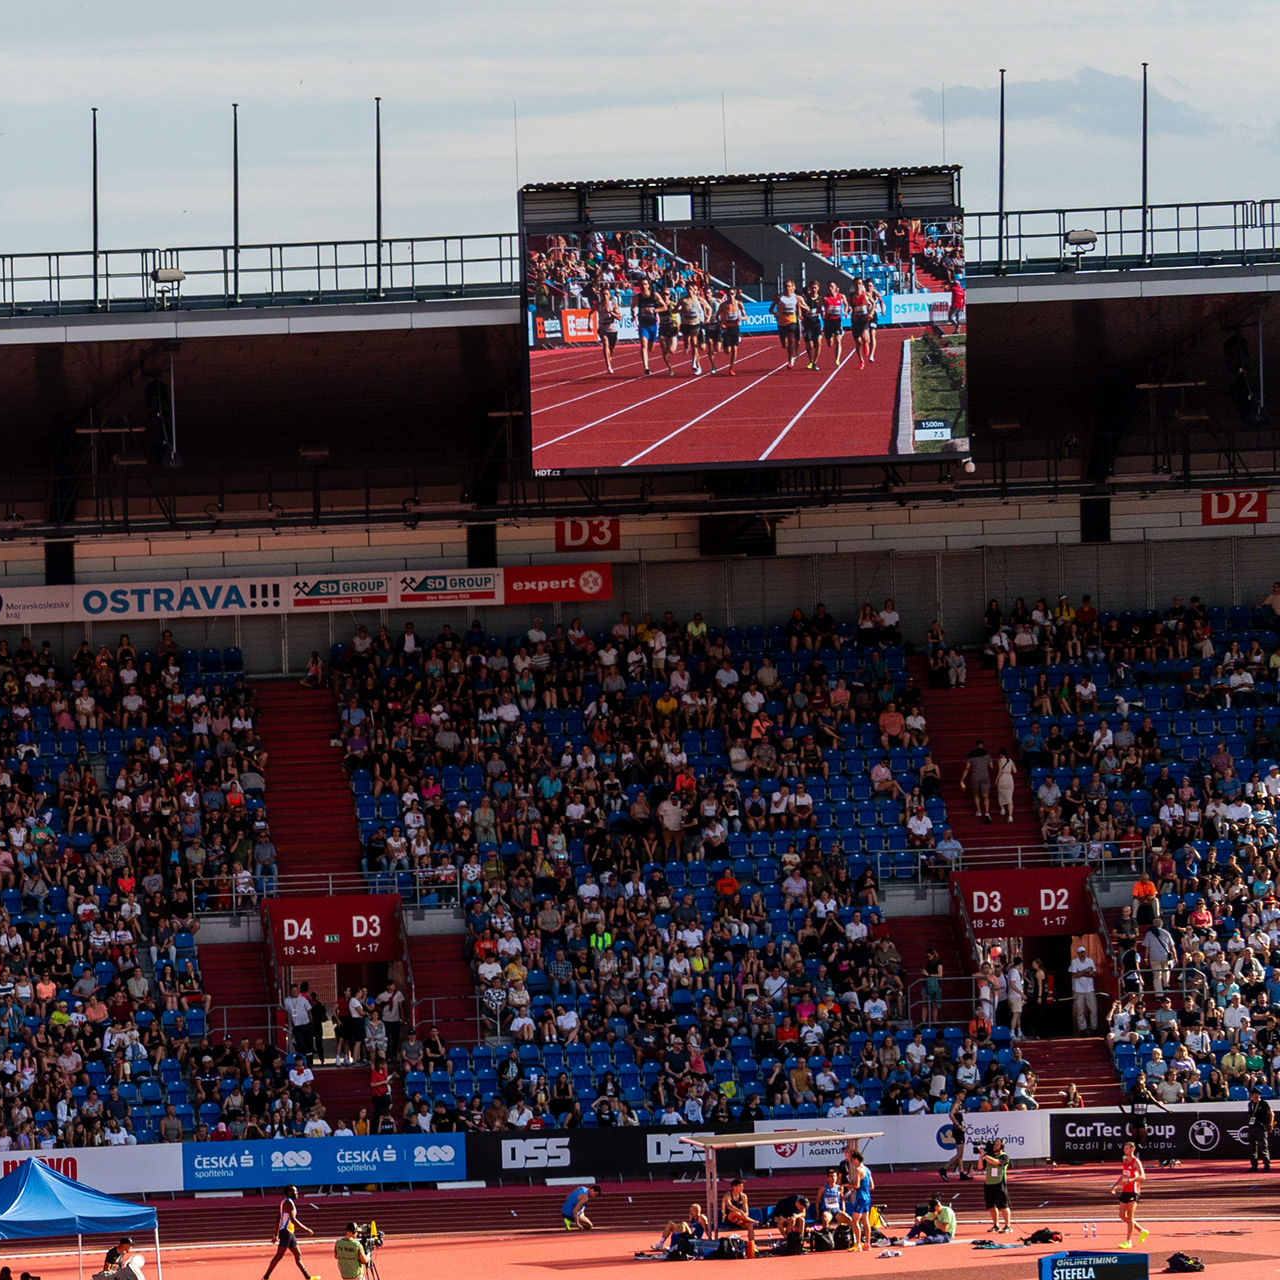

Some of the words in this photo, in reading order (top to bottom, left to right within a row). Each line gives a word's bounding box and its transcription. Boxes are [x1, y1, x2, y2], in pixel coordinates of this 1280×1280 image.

[535, 469, 561, 477] HDT.cz
[1211, 492, 1258, 519] D2
[564, 518, 612, 547] D3
[319, 583, 338, 594] SD
[342, 581, 384, 592] GROUP
[426, 578, 445, 590] SD
[449, 577, 492, 588] GROUP
[512, 577, 576, 592] expert
[5, 600, 70, 613] Moravskoslezský
[5, 611, 21, 620] kraj
[973, 891, 1002, 913] D3
[1040, 888, 1069, 910] D2
[284, 918, 313, 941] D4
[352, 915, 381, 938] D3
[965, 1124, 999, 1137] Český
[1065, 1123, 1122, 1138] CarTec
[1065, 1141, 1099, 1150] Rozdíl
[1103, 1141, 1112, 1151] je
[336, 1147, 380, 1163] ČESKÁ
[501, 1137, 570, 1169] DSS
[194, 1153, 238, 1170] ČESKÁ
[337, 1163, 376, 1173] spořitelna
[194, 1168, 234, 1179] spořitelna
[1057, 1256, 1118, 1267] ONLINETIMING
[1053, 1266, 1096, 1280] ŠTEFELA
